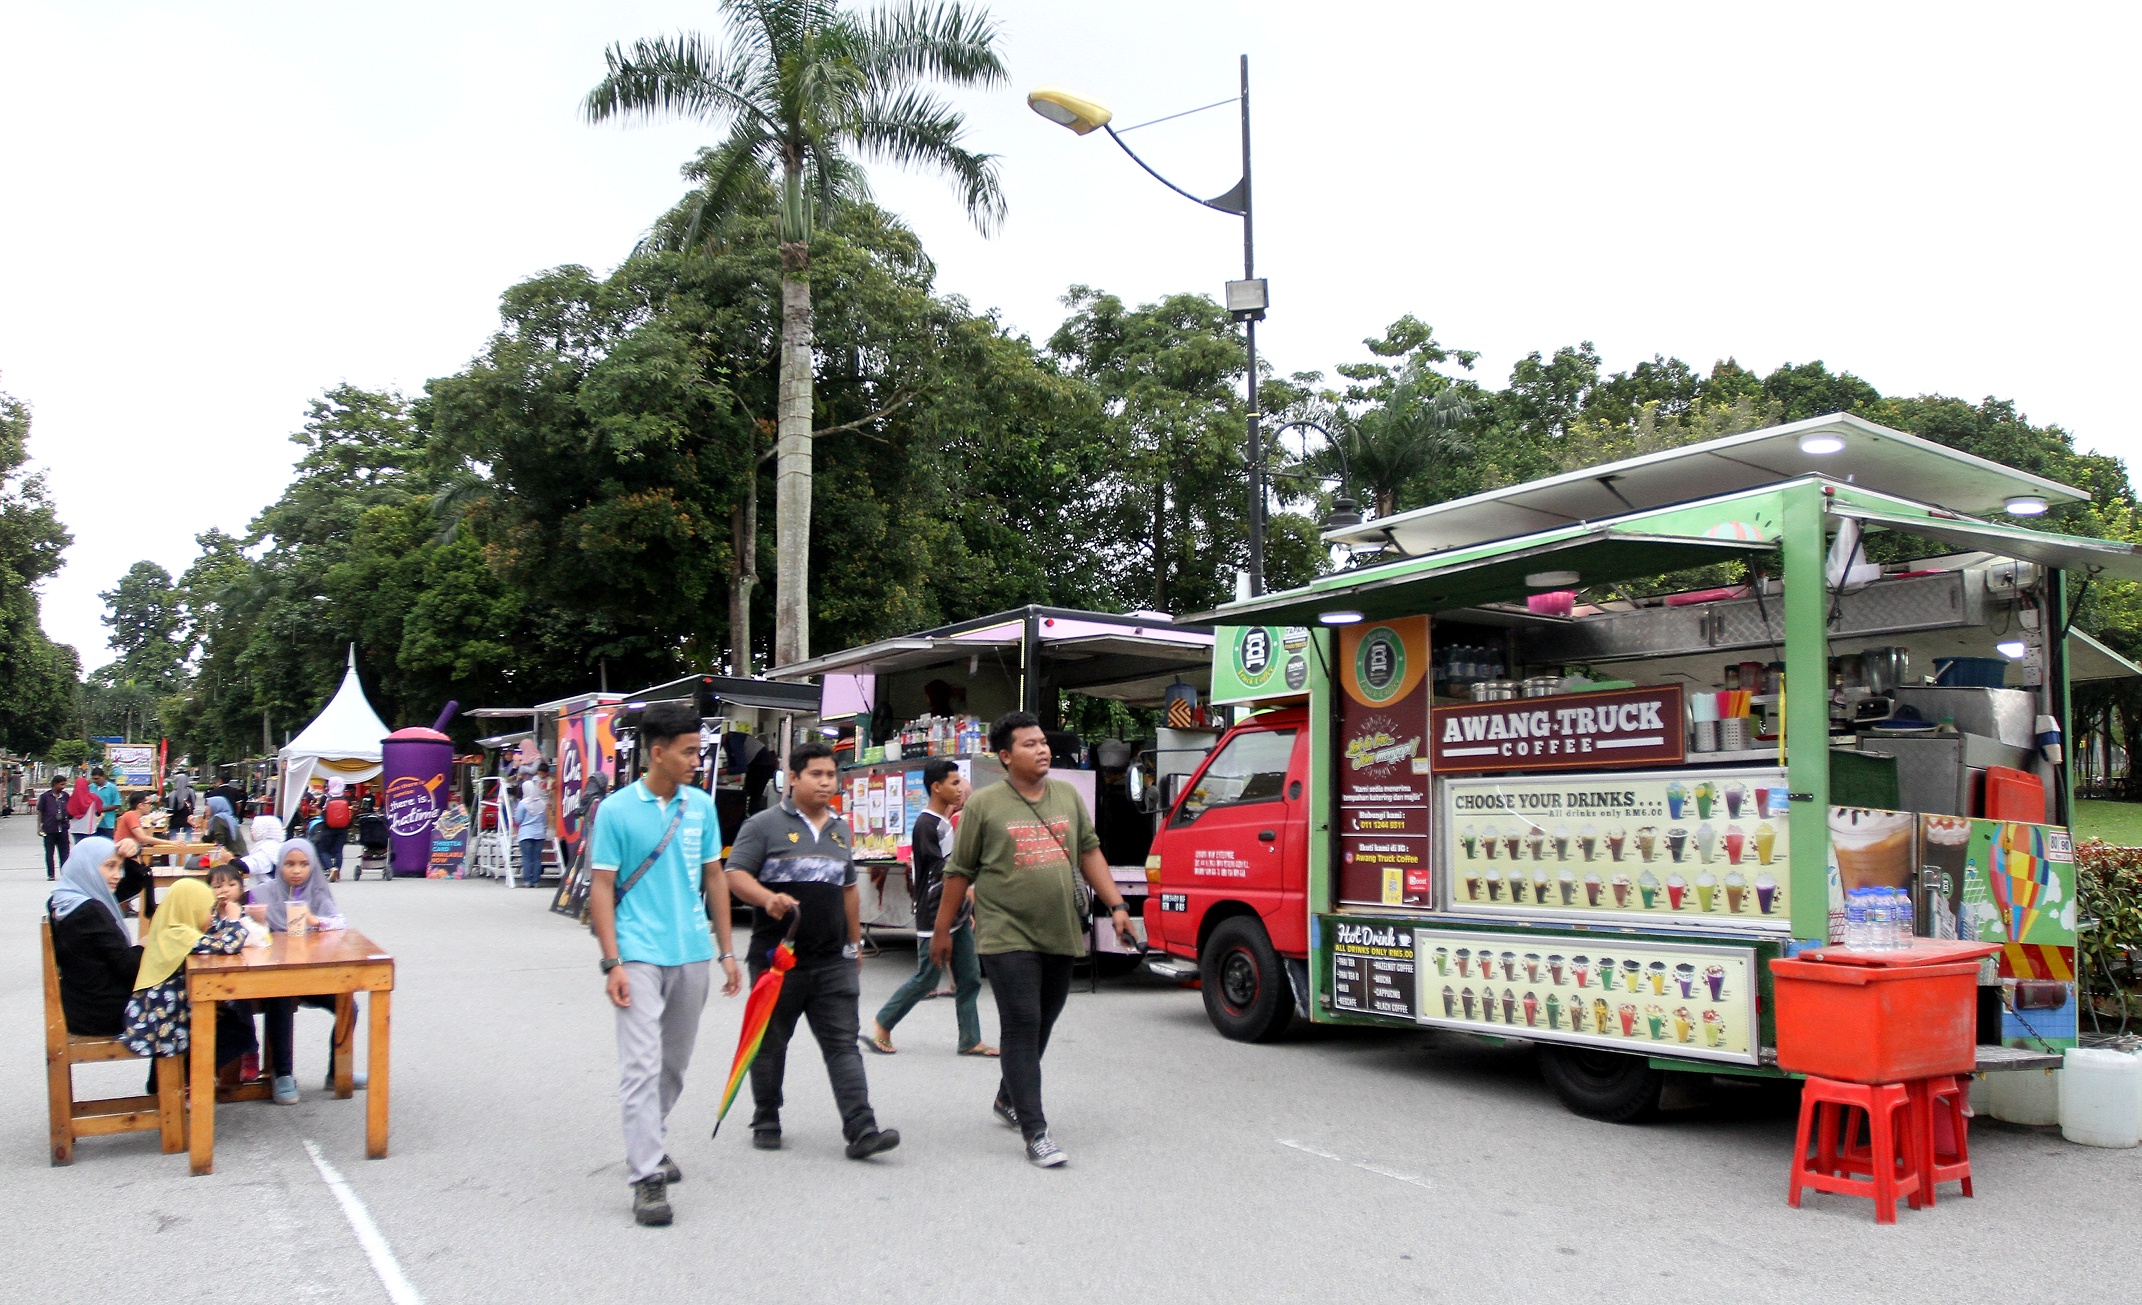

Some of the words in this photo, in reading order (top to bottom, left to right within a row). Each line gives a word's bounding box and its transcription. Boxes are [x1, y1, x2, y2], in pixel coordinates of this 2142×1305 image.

[1443, 710, 1550, 743] AWANG
[1556, 700, 1665, 735] TRUCK
[1502, 737, 1592, 757] COFFEE
[1369, 794, 1393, 802] katering
[1455, 793, 1516, 810] CHOOSE
[1518, 792, 1563, 808] YOUR
[1567, 791, 1636, 808] DRINKS
[390, 797, 416, 811] there
[1359, 811, 1386, 820] Hubungi
[1548, 809, 1563, 817] All
[1566, 808, 1597, 817] drinks
[1600, 809, 1621, 819] only
[1625, 808, 1663, 817] RM6.00
[1355, 854, 1377, 863] Awang
[1378, 854, 1395, 863] Truck
[1396, 855, 1419, 863] Coffee
[1337, 923, 1362, 943] Hot
[1362, 926, 1396, 947] Drink
[1335, 944, 1346, 952] ALL
[1347, 945, 1370, 955] DRINKS
[1371, 947, 1388, 956] ONLY
[1397, 964, 1414, 973] COFFEE
[1392, 1003, 1408, 1014] COFFEE
